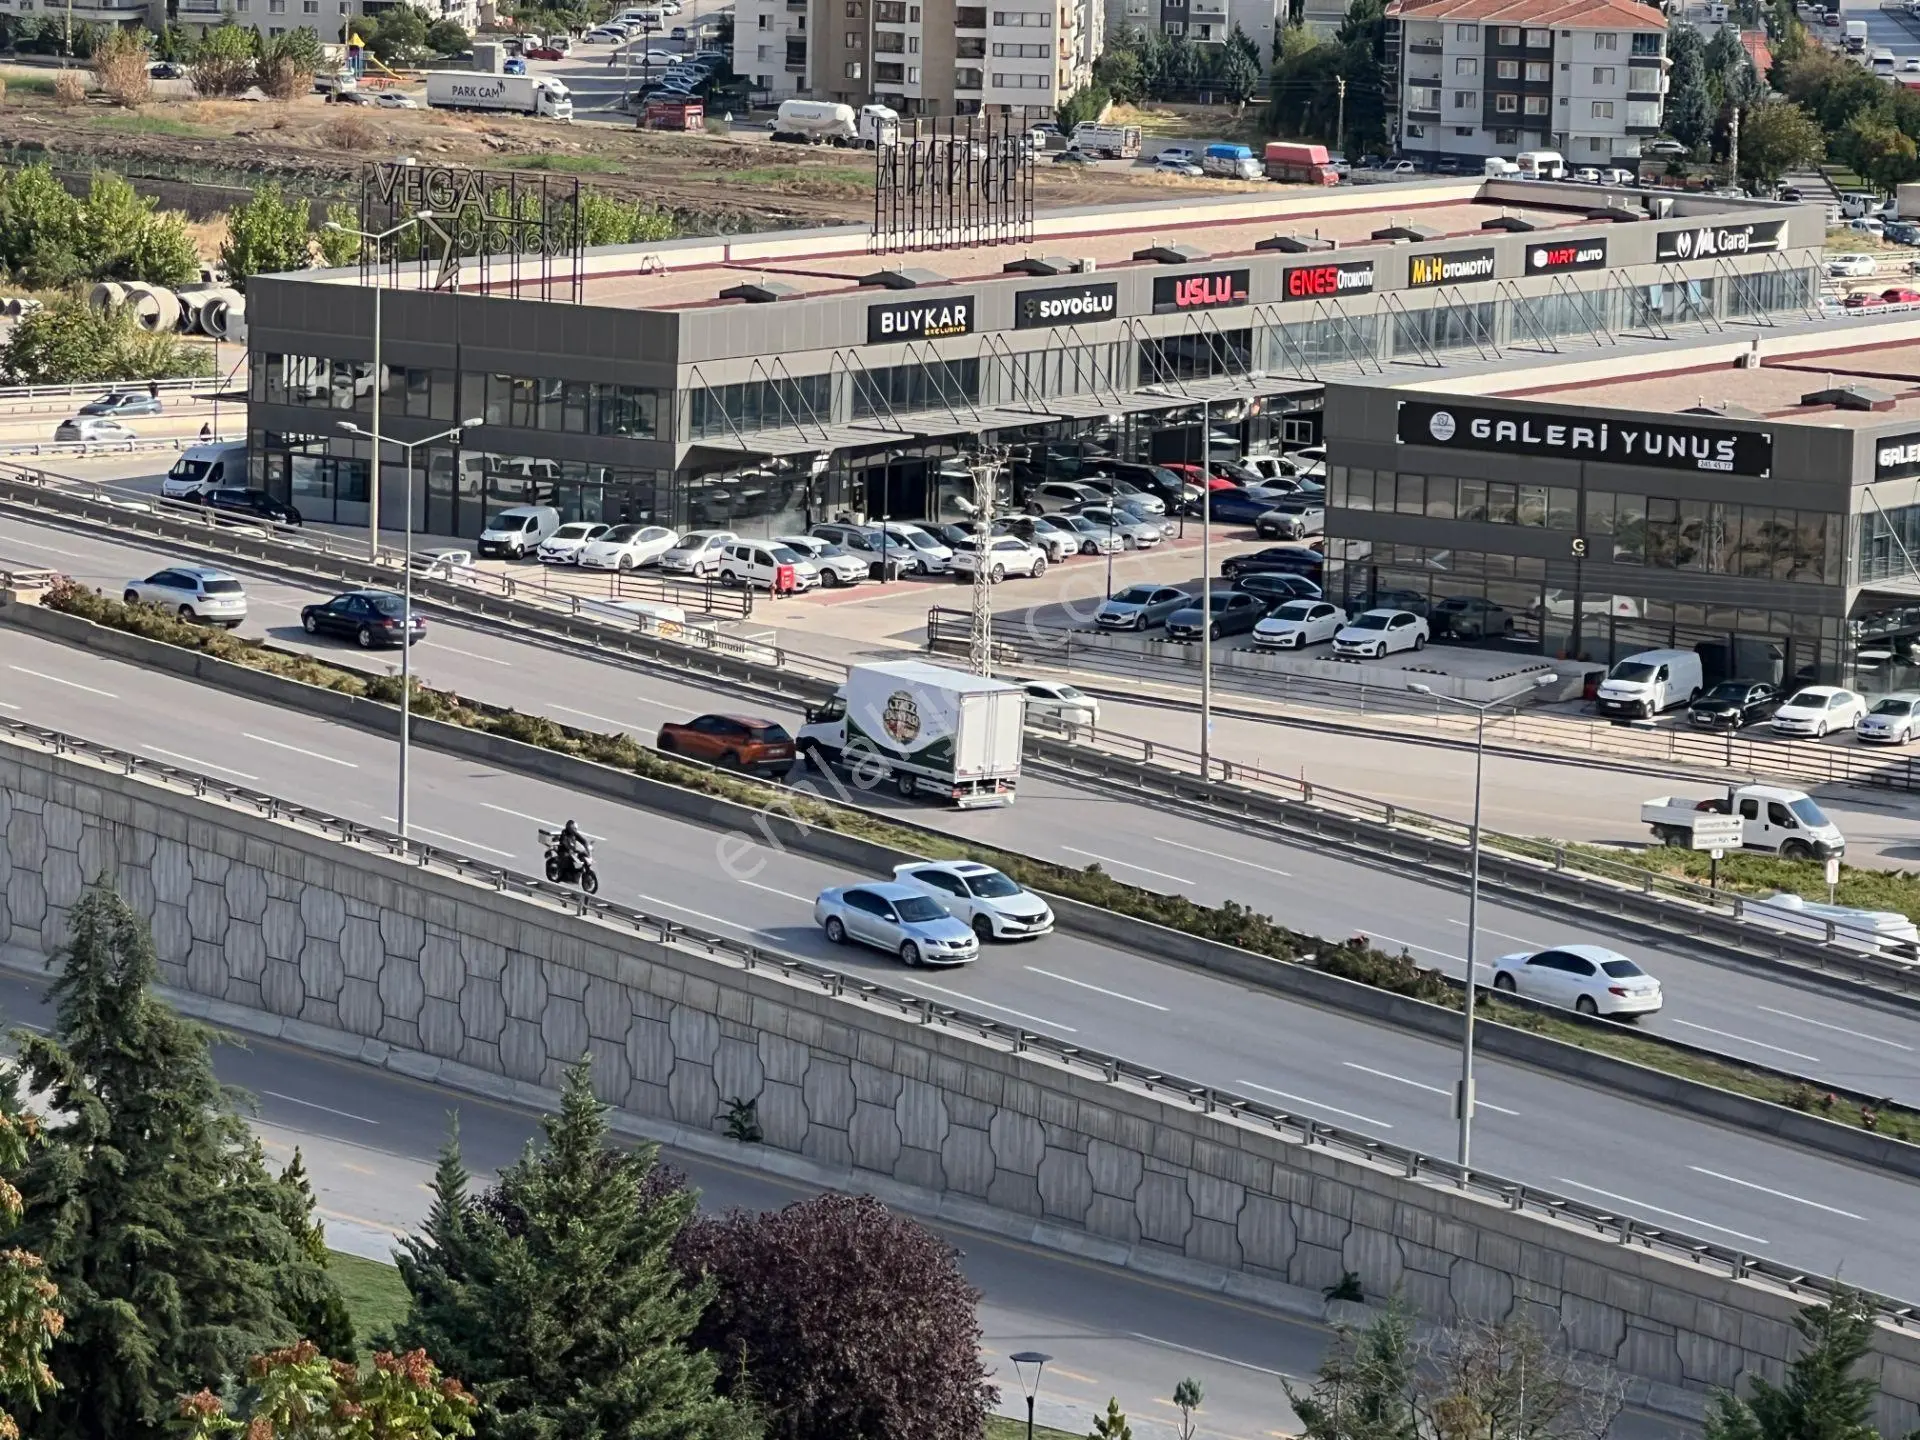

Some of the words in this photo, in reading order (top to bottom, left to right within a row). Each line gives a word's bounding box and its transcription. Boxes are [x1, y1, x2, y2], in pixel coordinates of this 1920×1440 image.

[451, 85, 477, 97] PARK
[479, 87, 500, 98] CAM
[372, 161, 488, 213] VEGA
[1718, 228, 1751, 254] Garaj
[1548, 249, 1576, 264] MRT
[1576, 248, 1603, 262] AUTO
[1289, 267, 1337, 296] ENES
[1412, 257, 1442, 284] M&H
[1176, 275, 1231, 306] USLU
[1040, 291, 1113, 318] SOYOĞLU
[881, 305, 967, 334] BUYKAR
[1471, 418, 1608, 452] GALERİ
[1621, 431, 1736, 461] YUNUS
[1879, 443, 1920, 468] GALE
